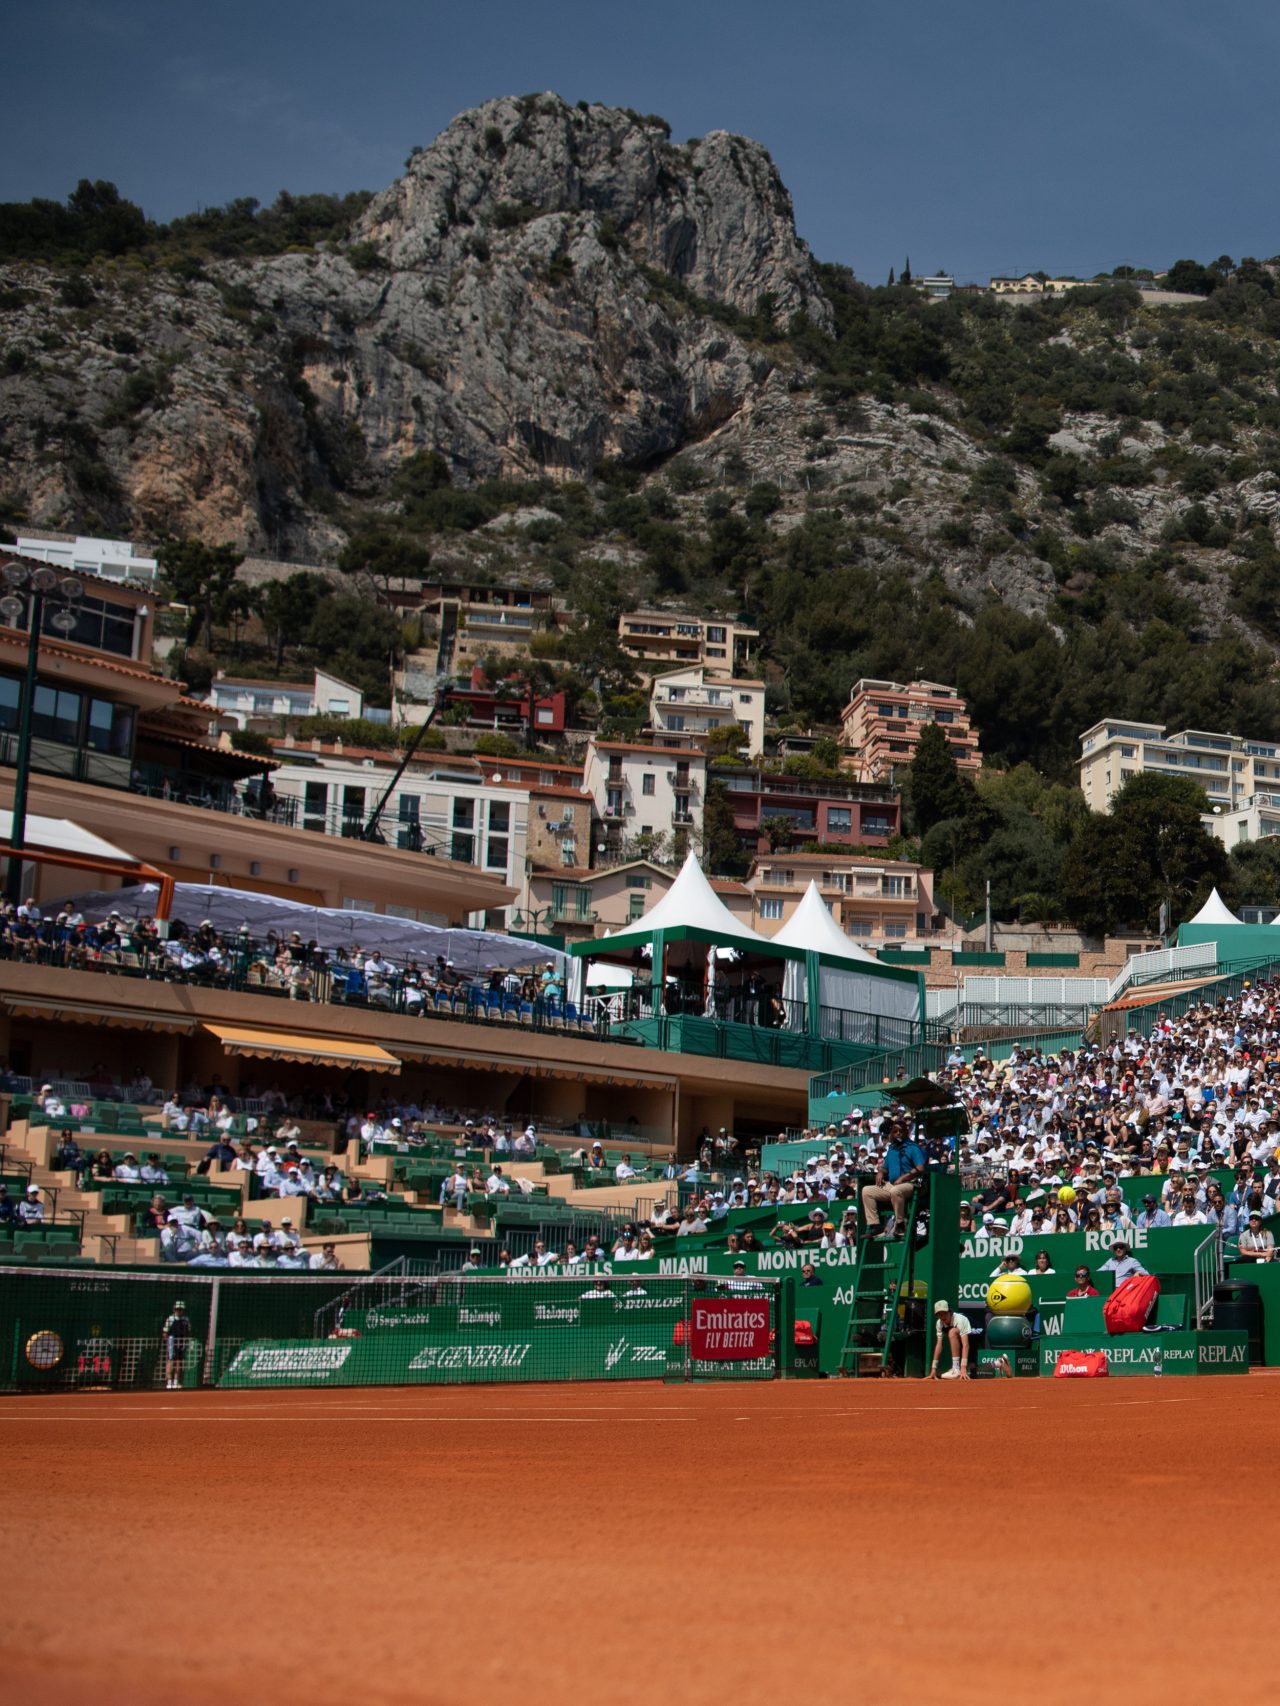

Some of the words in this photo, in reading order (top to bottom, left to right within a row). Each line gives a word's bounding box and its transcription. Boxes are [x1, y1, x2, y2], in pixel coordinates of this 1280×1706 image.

[959, 1236, 1024, 1259] ADRID
[1086, 1229, 1148, 1251] ROME
[659, 1256, 709, 1275] MIAMI
[758, 1246, 889, 1271] MONTE-CA
[507, 1265, 558, 1283] INDIAN
[562, 1262, 613, 1276] WELLS
[696, 1309, 765, 1330] Emirates
[706, 1332, 720, 1349] FLY
[723, 1331, 755, 1348] BETTER
[794, 1358, 818, 1368] EPLAY
[1101, 1346, 1157, 1364] REPLAY
[1164, 1349, 1195, 1360] REPLAY
[1199, 1345, 1246, 1363] REPLAY
